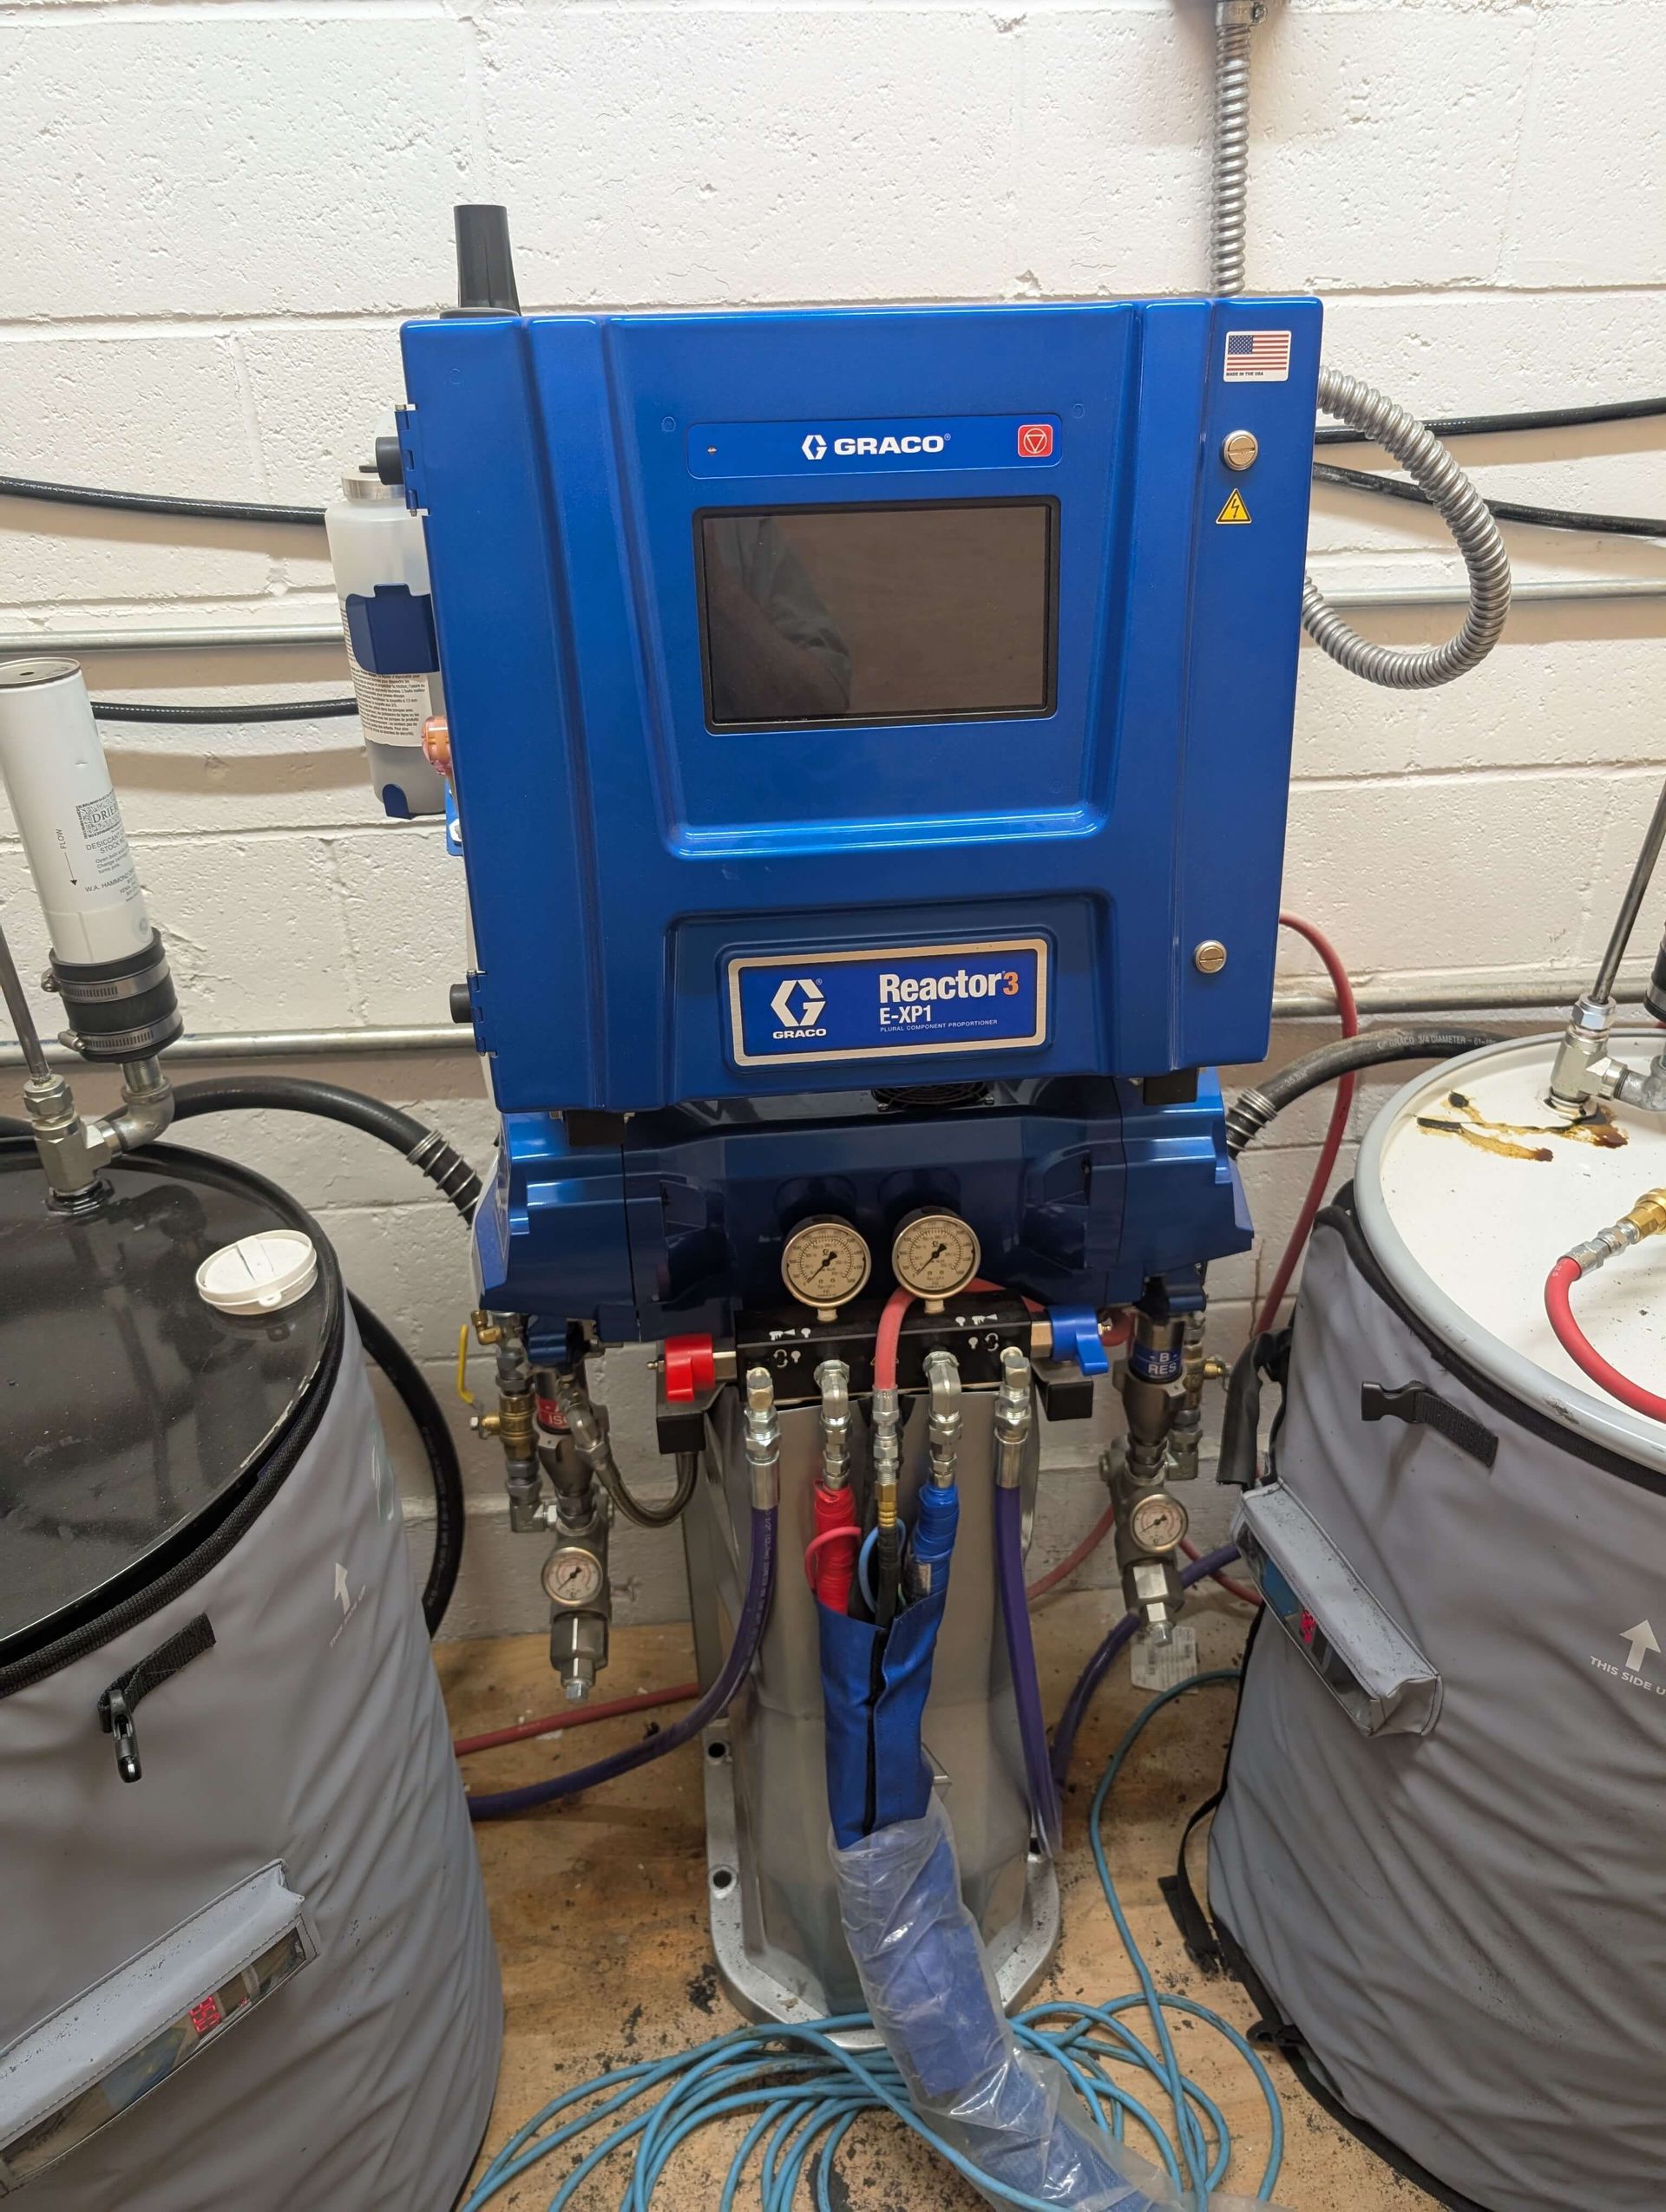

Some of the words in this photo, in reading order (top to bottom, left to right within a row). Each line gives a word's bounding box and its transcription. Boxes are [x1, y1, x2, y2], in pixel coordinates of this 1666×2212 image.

[56, 828, 68, 849] FLOW
[880, 1005, 932, 1025] E-XP1
[948, 1019, 998, 1028] PROPORTIONER
[772, 1028, 827, 1039] GRACO
[1430, 1033, 1466, 1044] DIAMETER
[1148, 1362, 1177, 1375] RES
[1590, 1655, 1619, 1676] THIS
[1621, 1672, 1653, 1691] SIDE
